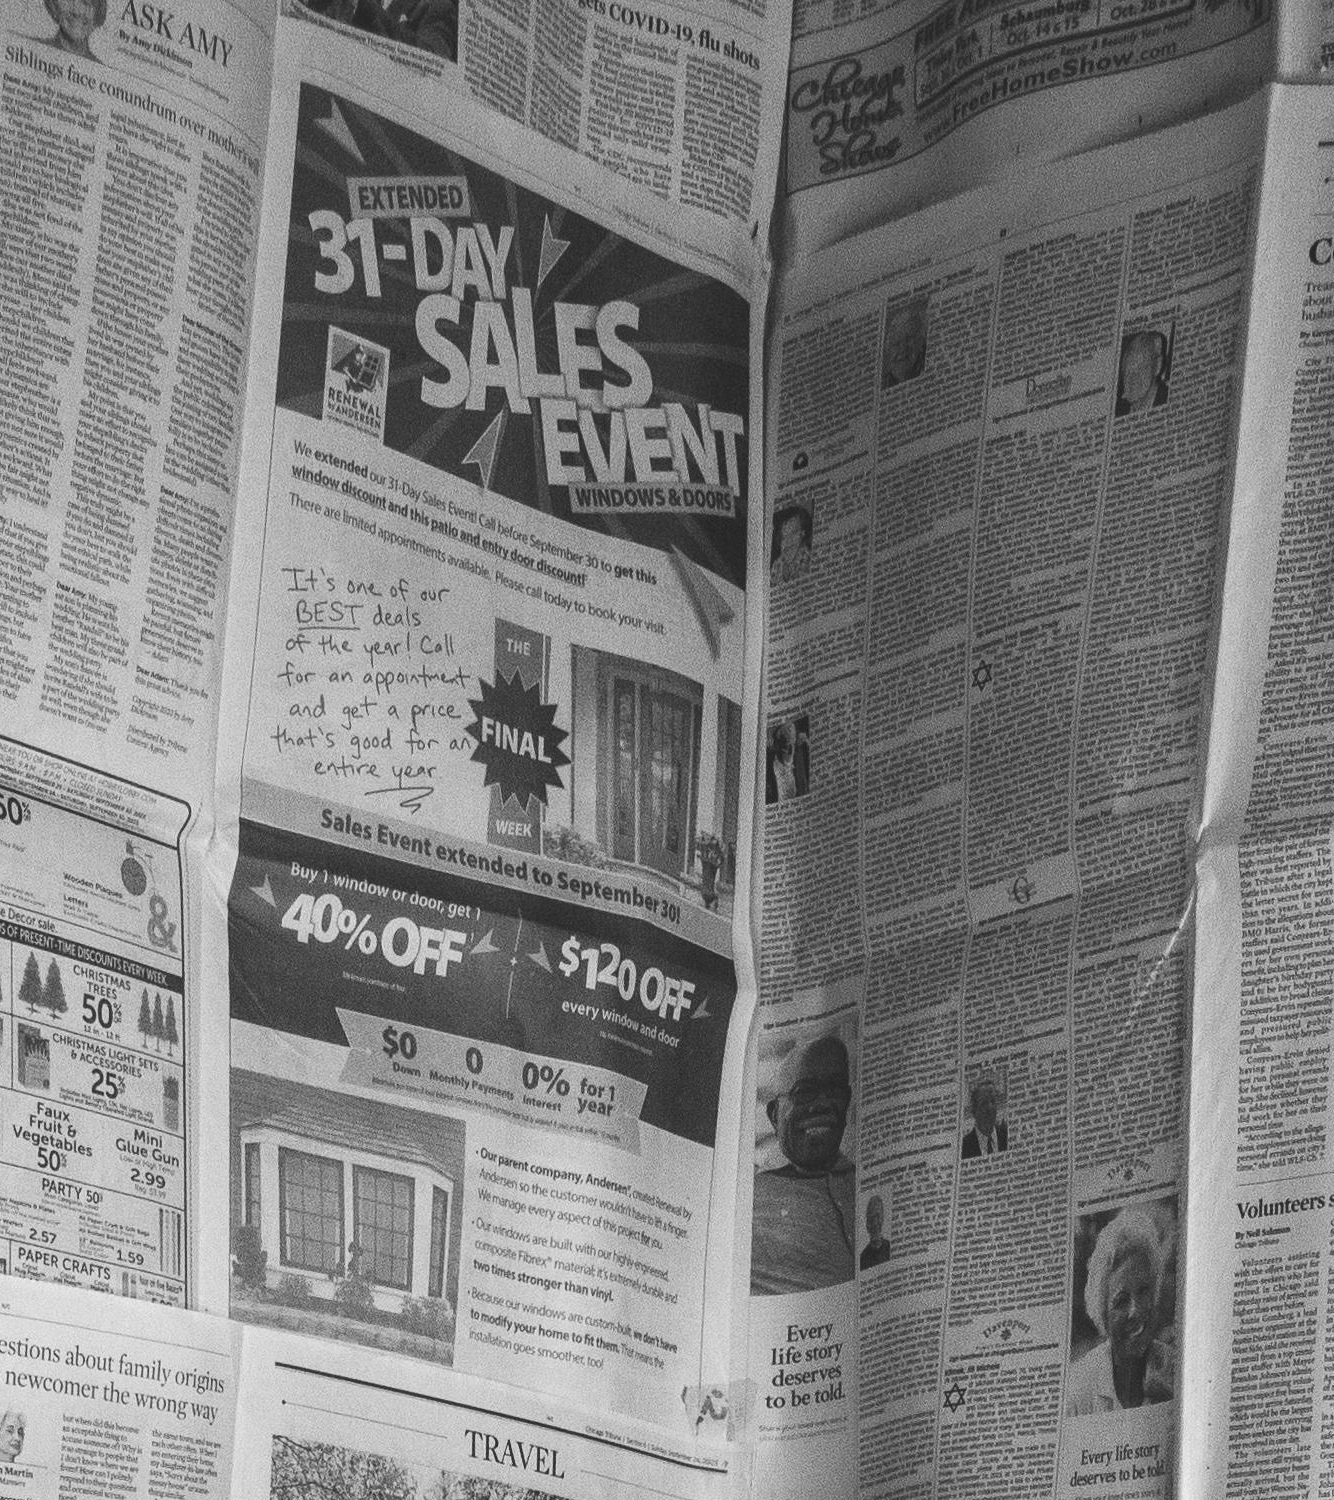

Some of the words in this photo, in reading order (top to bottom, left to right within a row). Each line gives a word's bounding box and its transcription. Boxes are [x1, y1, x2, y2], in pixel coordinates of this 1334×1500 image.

[122, 0, 174, 40] ASK
[179, 23, 233, 67] AMY
[359, 184, 463, 212] EXTENDED
[309, 210, 514, 300] 31-DAY
[415, 287, 653, 414] SALES
[540, 398, 743, 497] EVENT
[575, 487, 665, 506] WINDOWS
[668, 488, 680, 506] &
[682, 488, 731, 511] DOORS
[281, 567, 336, 592] It's
[347, 579, 383, 597] one
[390, 578, 409, 601] of
[421, 589, 450, 602] our
[296, 599, 364, 625] BEST
[373, 603, 422, 627] deals
[285, 633, 311, 653] of
[318, 635, 353, 655] the
[363, 631, 412, 668] year!
[420, 633, 454, 656] Call
[507, 638, 530, 656] THE
[277, 662, 316, 687] for
[328, 671, 353, 684] an
[363, 664, 470, 695] appointment
[289, 694, 326, 718] and
[341, 696, 378, 731] get
[388, 705, 399, 719] a
[410, 704, 462, 731] price
[270, 724, 335, 753] that's
[350, 728, 392, 760] good
[405, 728, 439, 755] for
[449, 737, 471, 751] an
[482, 717, 551, 763] FINAL
[314, 755, 380, 777] entire
[391, 765, 437, 789] year
[496, 820, 531, 837] WEEK
[281, 894, 379, 954] 40%
[379, 917, 467, 976] OFF
[1236, 1195, 1325, 1219] Volunteers
[465, 1429, 565, 1479] TRAVEL
